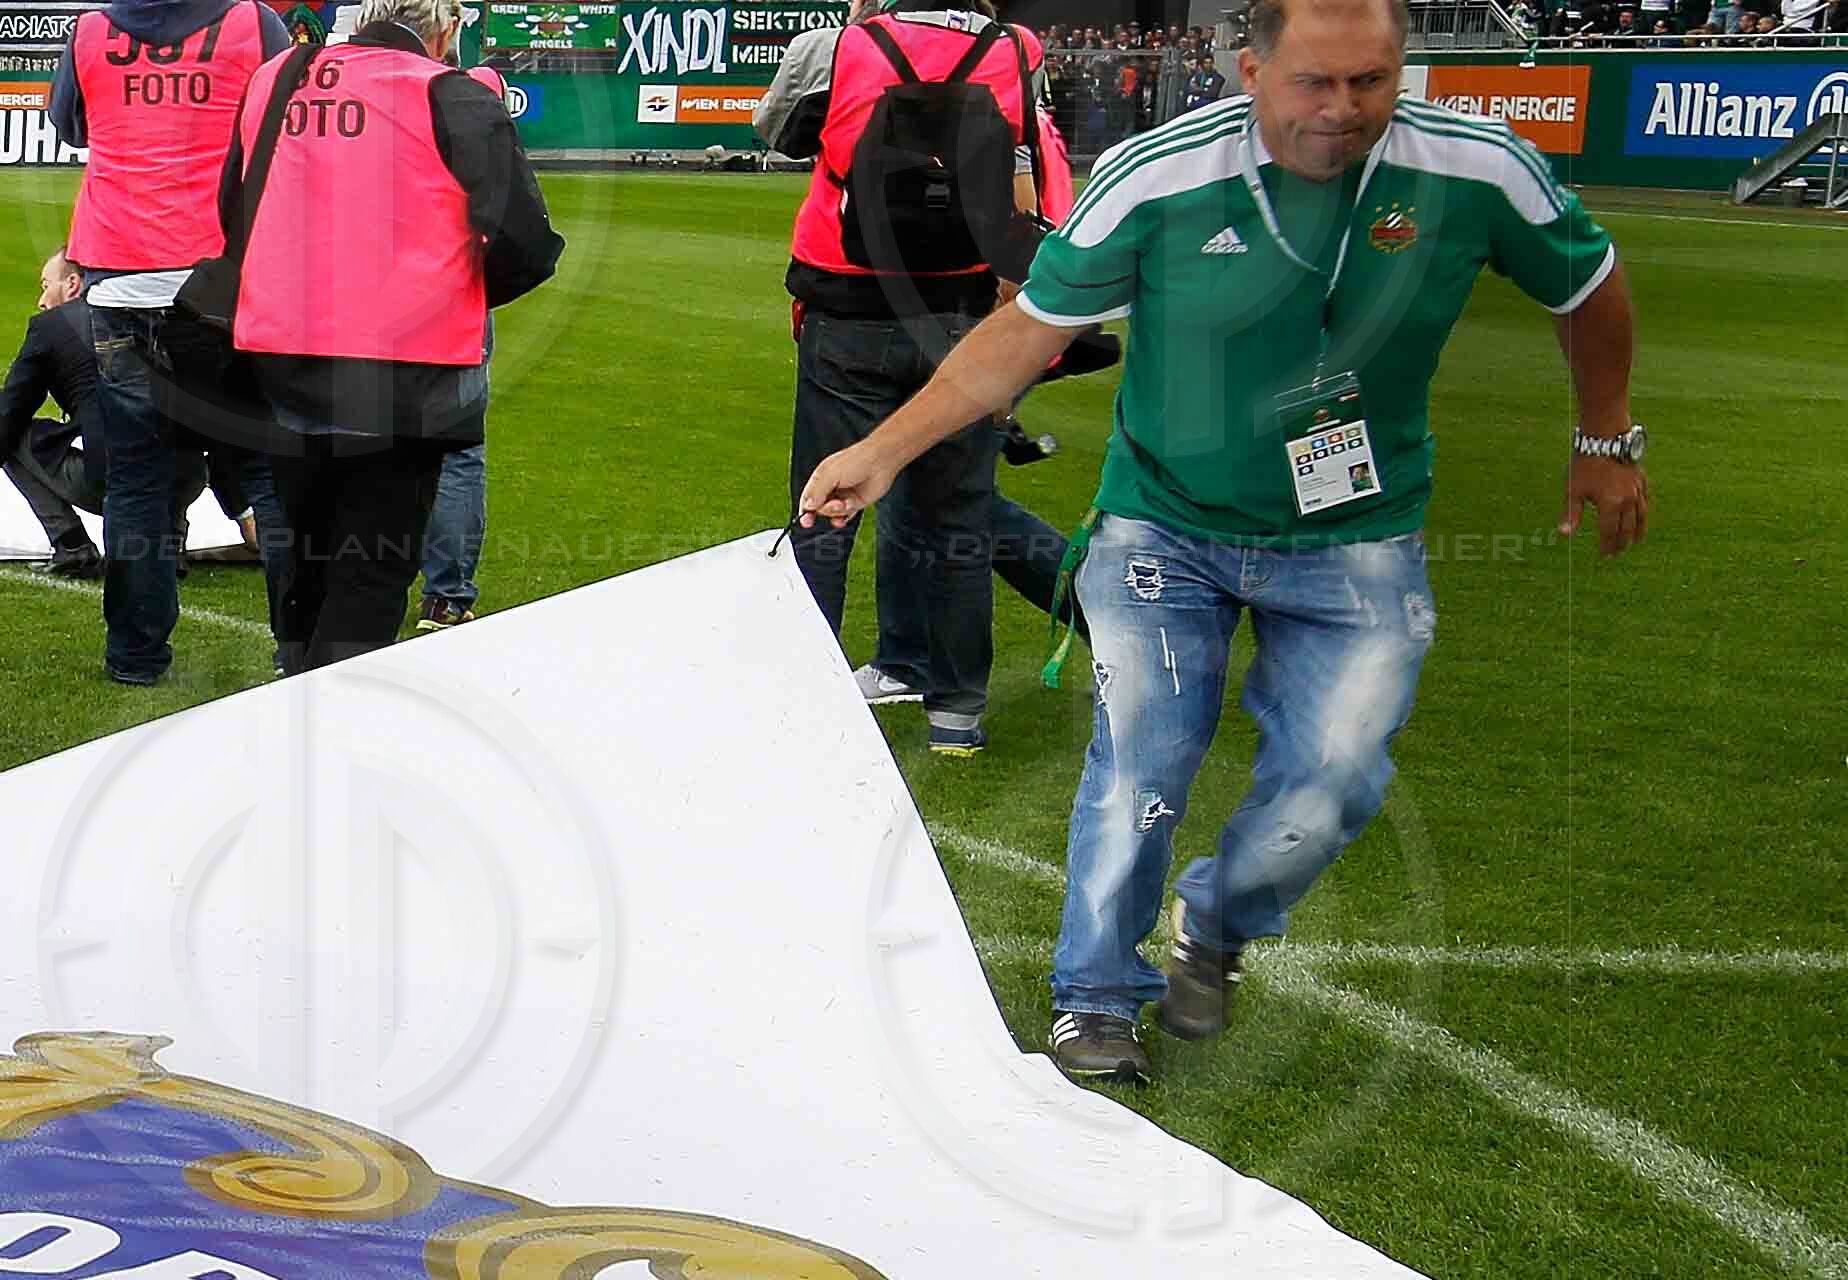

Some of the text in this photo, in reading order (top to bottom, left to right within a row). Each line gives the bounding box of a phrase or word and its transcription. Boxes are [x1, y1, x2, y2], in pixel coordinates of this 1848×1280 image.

[579, 4, 617, 15] WHITE
[732, 10, 843, 31] SEKTION
[529, 39, 574, 50] ANGELS
[617, 6, 727, 76] XINDL
[123, 71, 212, 106] FOTO
[681, 98, 763, 110] WIEN ENER
[1490, 96, 1576, 121] ENERGIE
[1645, 82, 1798, 139] Allianz
[285, 99, 367, 138] OTO
